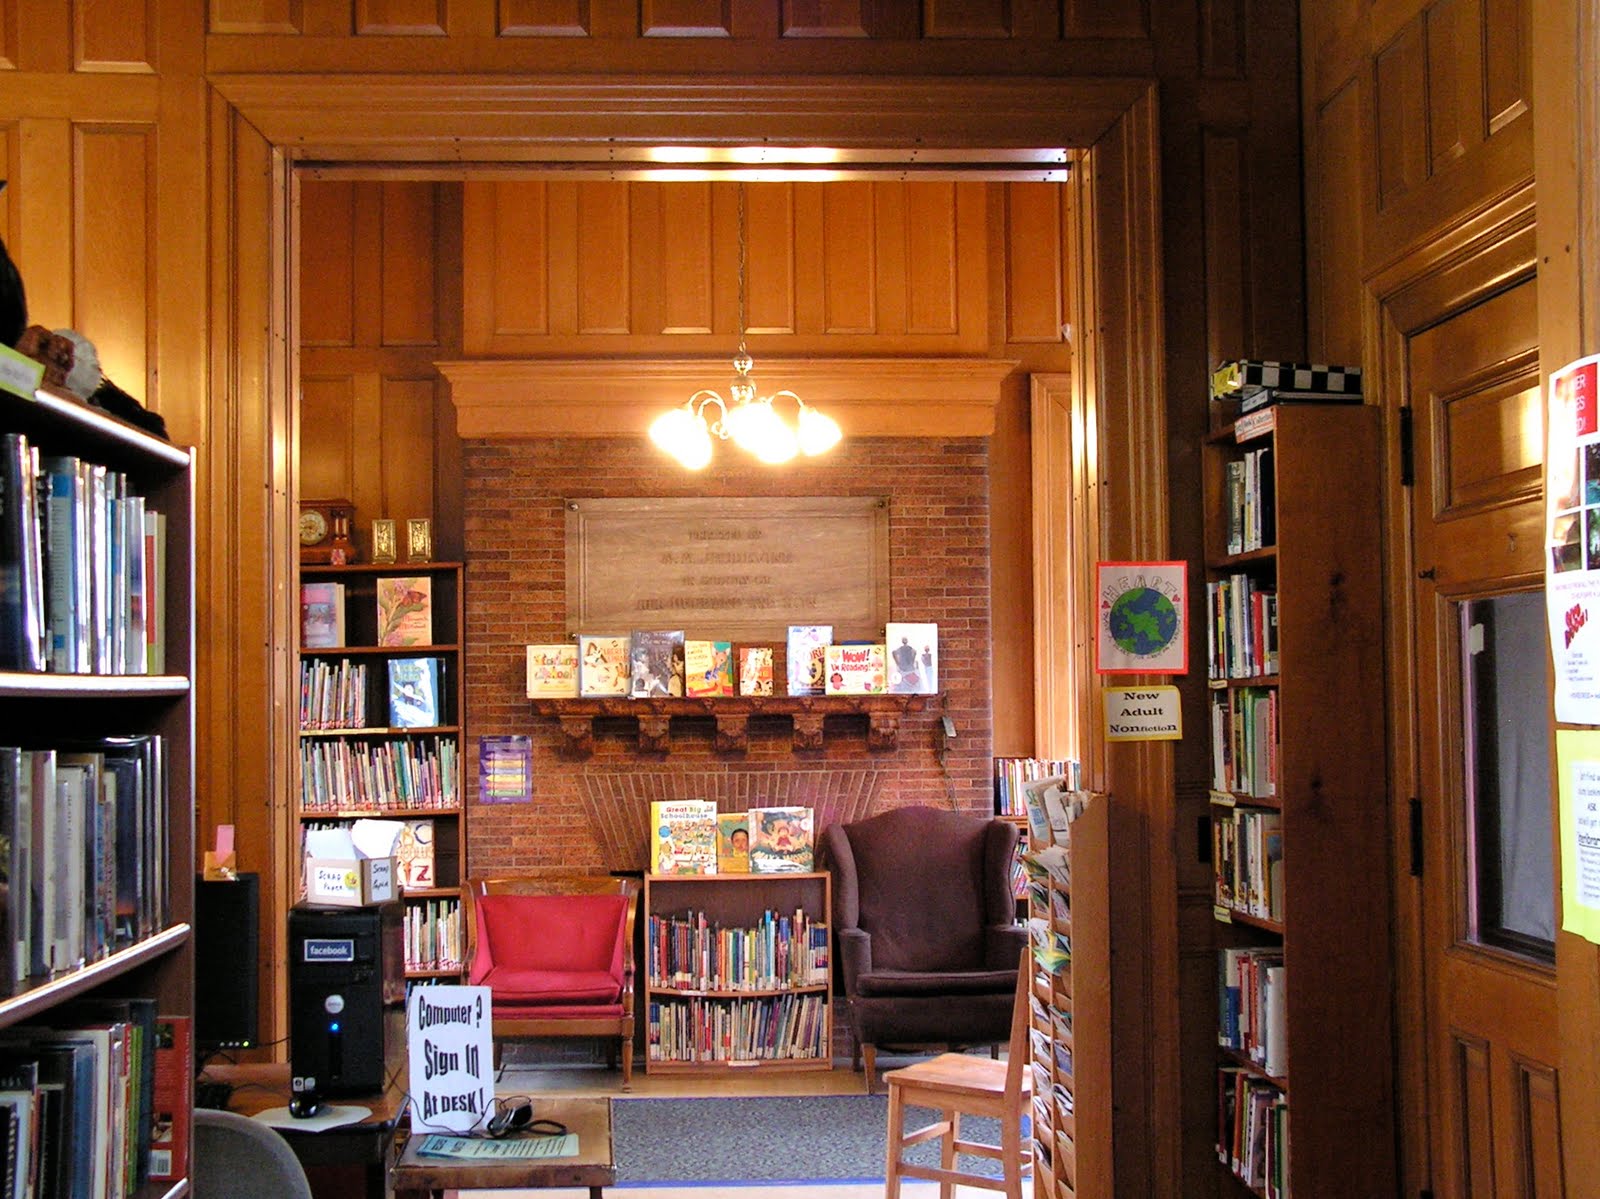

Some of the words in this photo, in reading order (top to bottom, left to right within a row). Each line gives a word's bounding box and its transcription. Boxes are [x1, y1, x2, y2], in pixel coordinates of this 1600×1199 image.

[1103, 575, 1178, 603] HEART
[842, 648, 871, 663] WOW!
[1124, 692, 1160, 701] New
[1120, 708, 1163, 717] Adult
[1109, 723, 1178, 733] Nonfiction
[310, 944, 348, 956] facebook
[419, 995, 472, 1030] Computer
[424, 1038, 459, 1080] Sign
[465, 1043, 480, 1080] In
[423, 1090, 438, 1121] At
